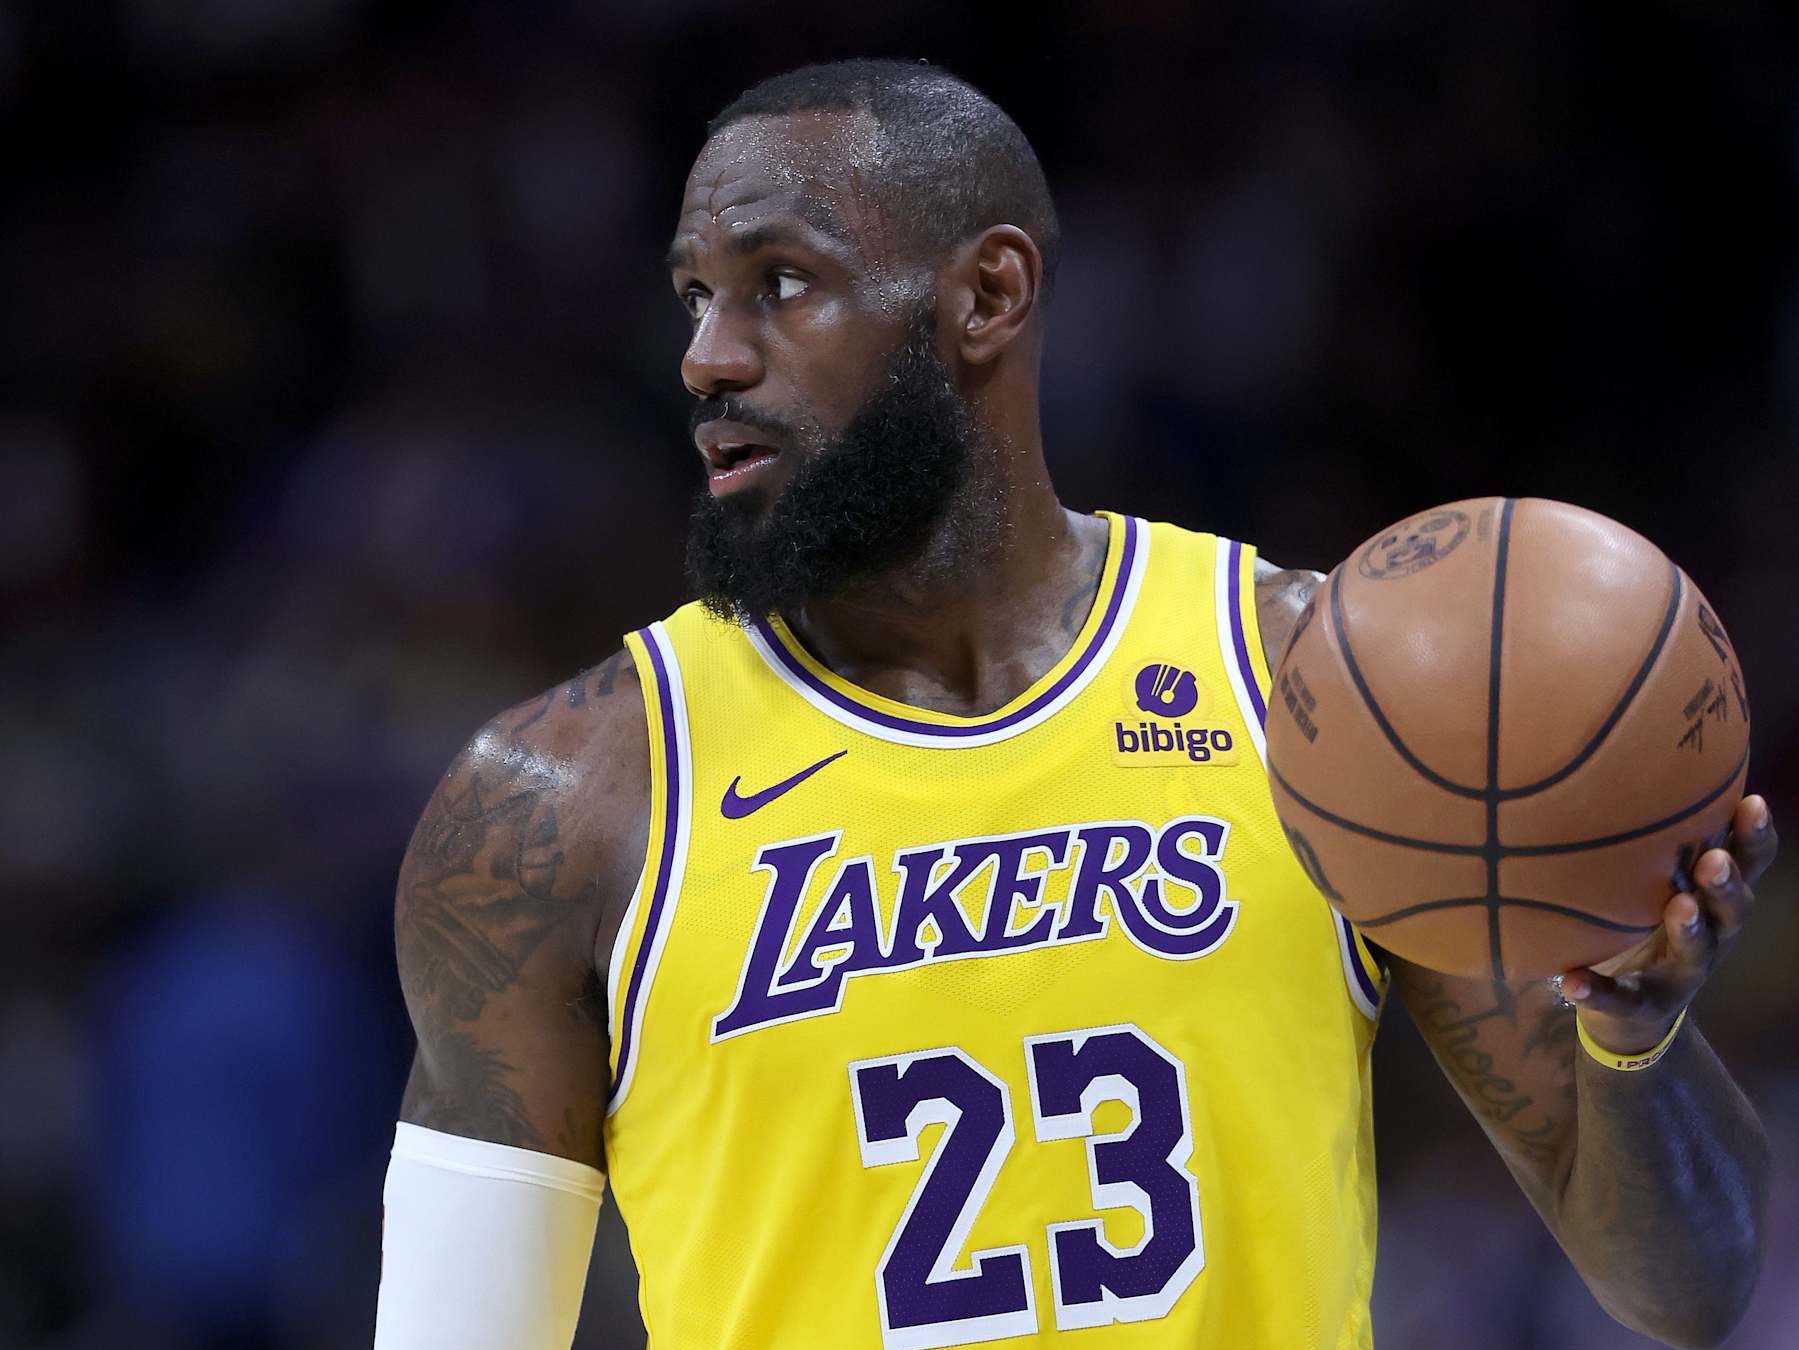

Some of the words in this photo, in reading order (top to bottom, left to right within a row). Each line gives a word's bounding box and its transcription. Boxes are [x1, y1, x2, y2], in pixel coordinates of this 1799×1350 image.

[1115, 722, 1233, 762] bibigo
[710, 815, 1240, 1045] LAKERS
[1626, 1050, 1663, 1068] PRO
